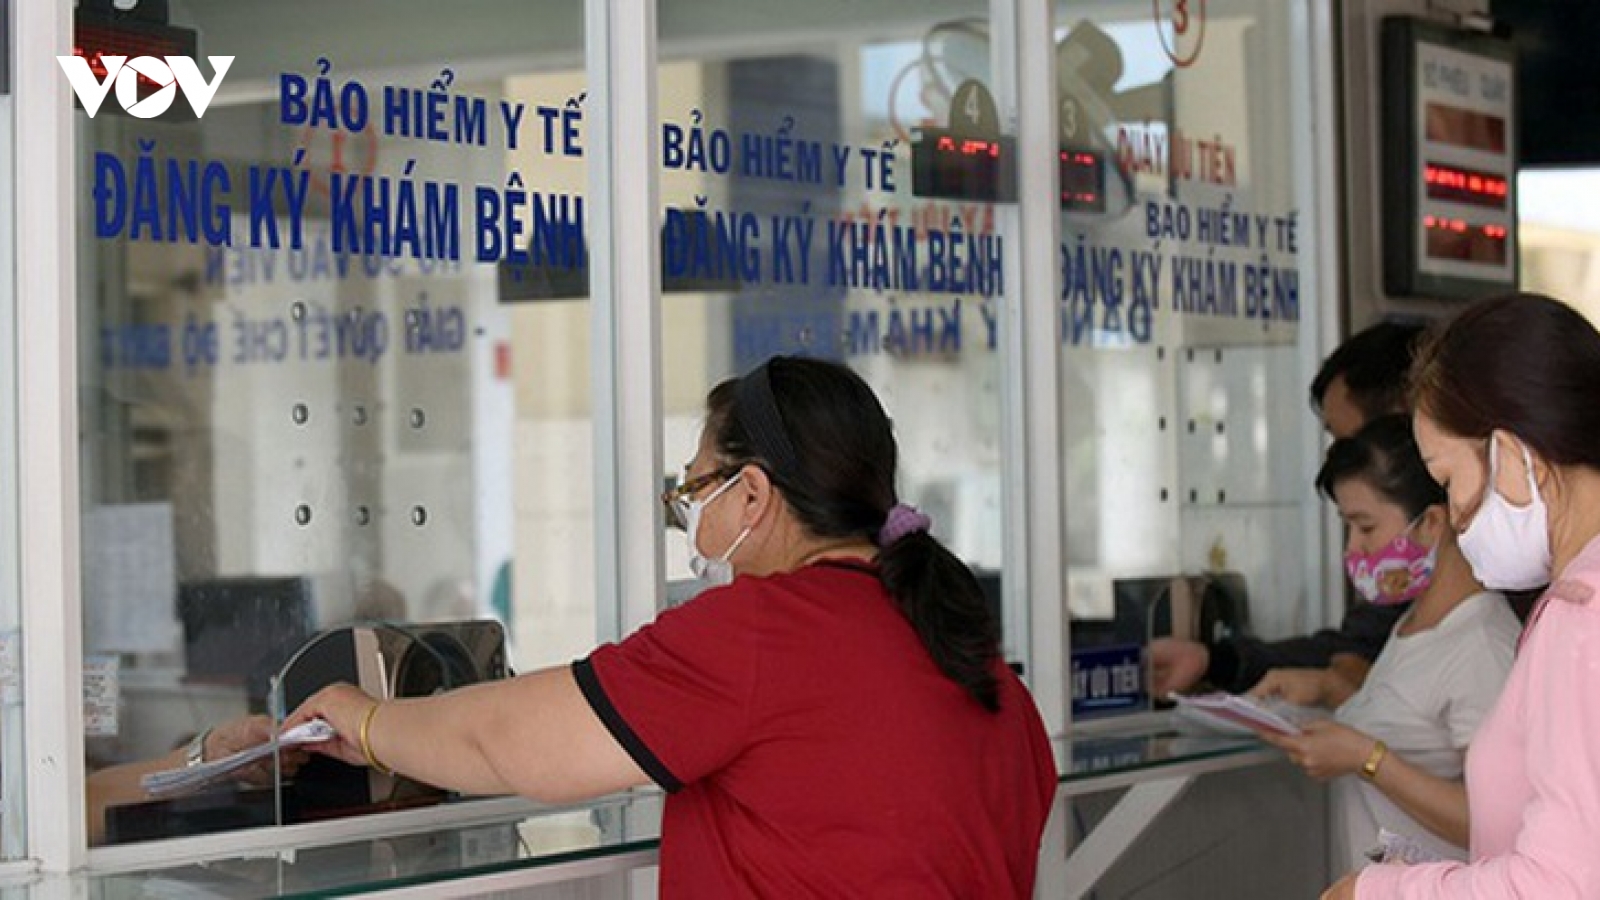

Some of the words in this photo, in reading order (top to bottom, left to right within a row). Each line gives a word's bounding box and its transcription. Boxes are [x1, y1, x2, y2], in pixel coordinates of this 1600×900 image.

[280, 59, 368, 133] BẢO
[384, 69, 486, 146] HIỂM
[500, 101, 525, 151] Y
[538, 93, 588, 157] TẾ
[964, 84, 979, 124] 4
[1062, 98, 1077, 138] 3
[662, 109, 731, 174] BẢO
[743, 116, 822, 183] HIỂM
[833, 143, 850, 187] Y
[860, 139, 900, 191] TẾ
[93, 140, 232, 249] ĐĂNG
[249, 150, 311, 250] KÝ
[331, 160, 460, 261] KHÁM
[475, 172, 584, 282] BỆNH
[664, 195, 760, 285] ĐĂNG
[772, 202, 815, 285] KÝ
[828, 210, 918, 291] KHÁM
[927, 216, 1003, 302] BỆNH
[1198, 193, 1249, 247] HIỂM
[1255, 214, 1269, 249] Y
[1274, 210, 1298, 253] TẾ
[1131, 240, 1162, 311] KÝ
[1171, 247, 1236, 317] KHÁM
[1244, 254, 1298, 331] BỆNH
